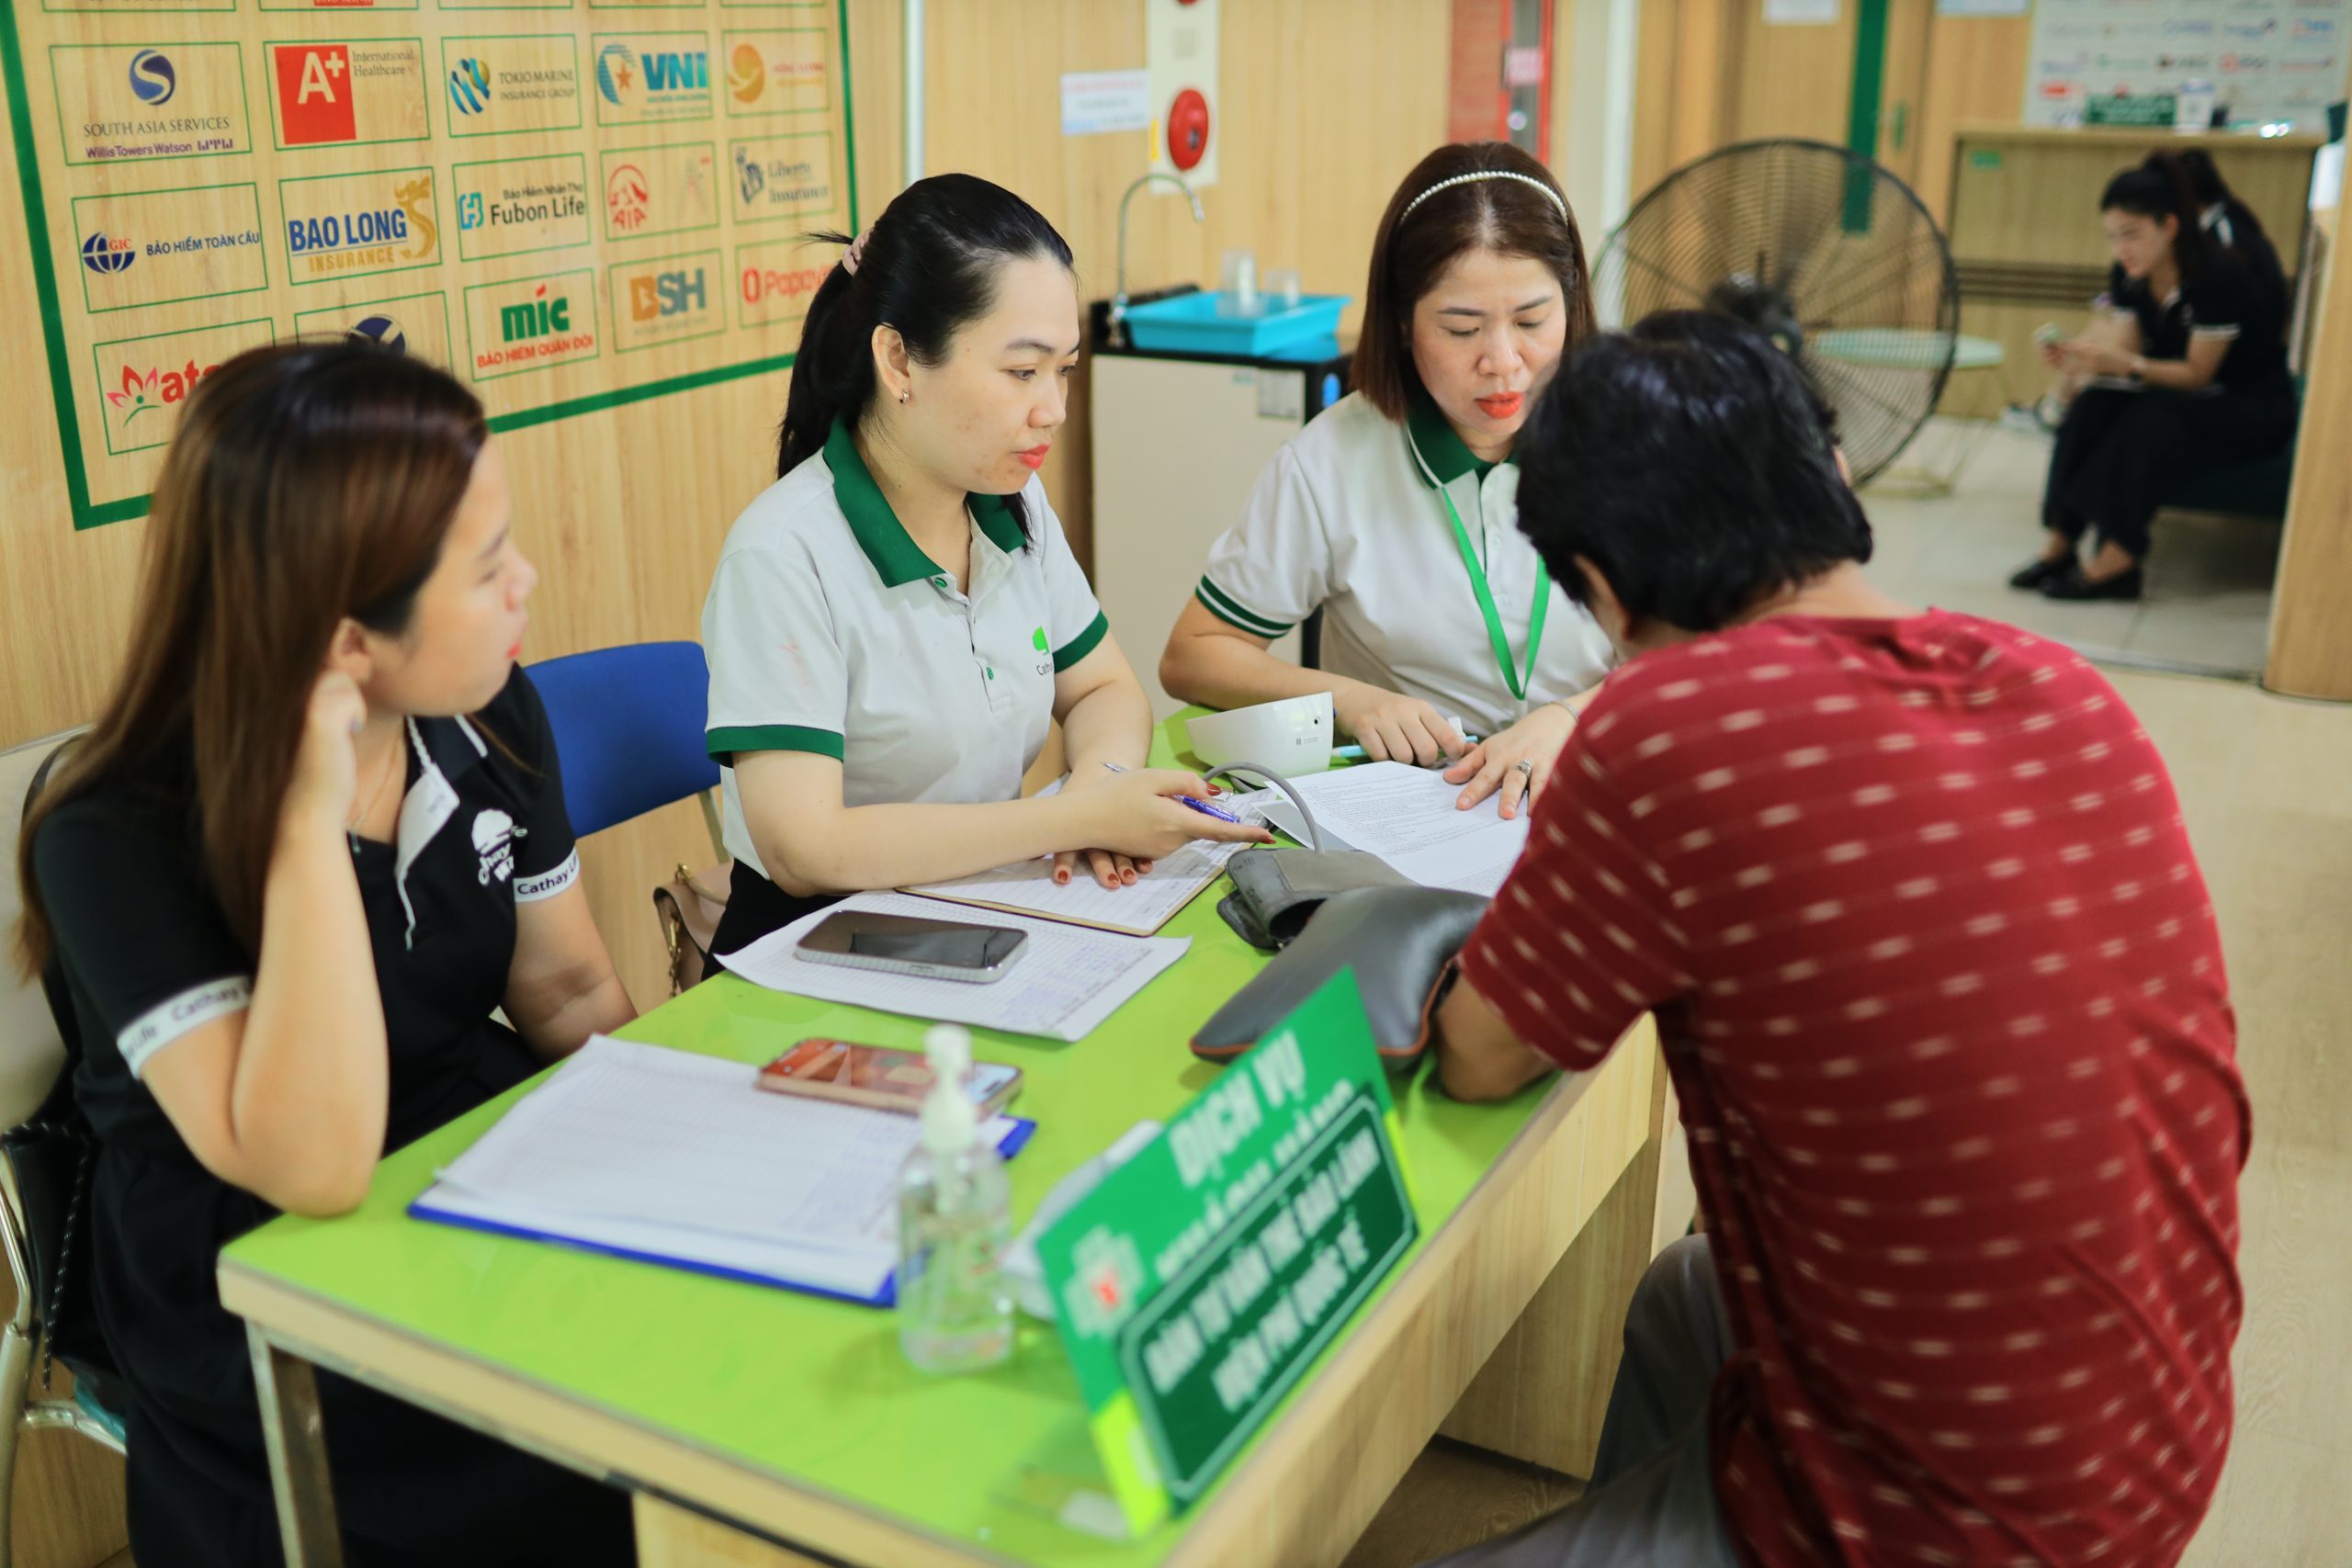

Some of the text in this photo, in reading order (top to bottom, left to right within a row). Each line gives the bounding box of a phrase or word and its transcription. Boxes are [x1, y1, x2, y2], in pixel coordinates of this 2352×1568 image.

[352, 49, 414, 62] International
[354, 64, 405, 76] Healthcare
[499, 68, 574, 85] TOKIO MARINE
[640, 51, 707, 91] VNI
[84, 117, 230, 138] SOUTH ASIA SERVICES
[85, 142, 192, 158] Willis Towers Watson
[490, 195, 585, 226] Fubon Life
[288, 209, 407, 252] BAO LONG
[108, 238, 132, 252] GIC
[309, 246, 394, 273] INSURANCE
[629, 267, 707, 321] BSH
[501, 283, 571, 343] mic
[517, 870, 569, 895] Cathay
